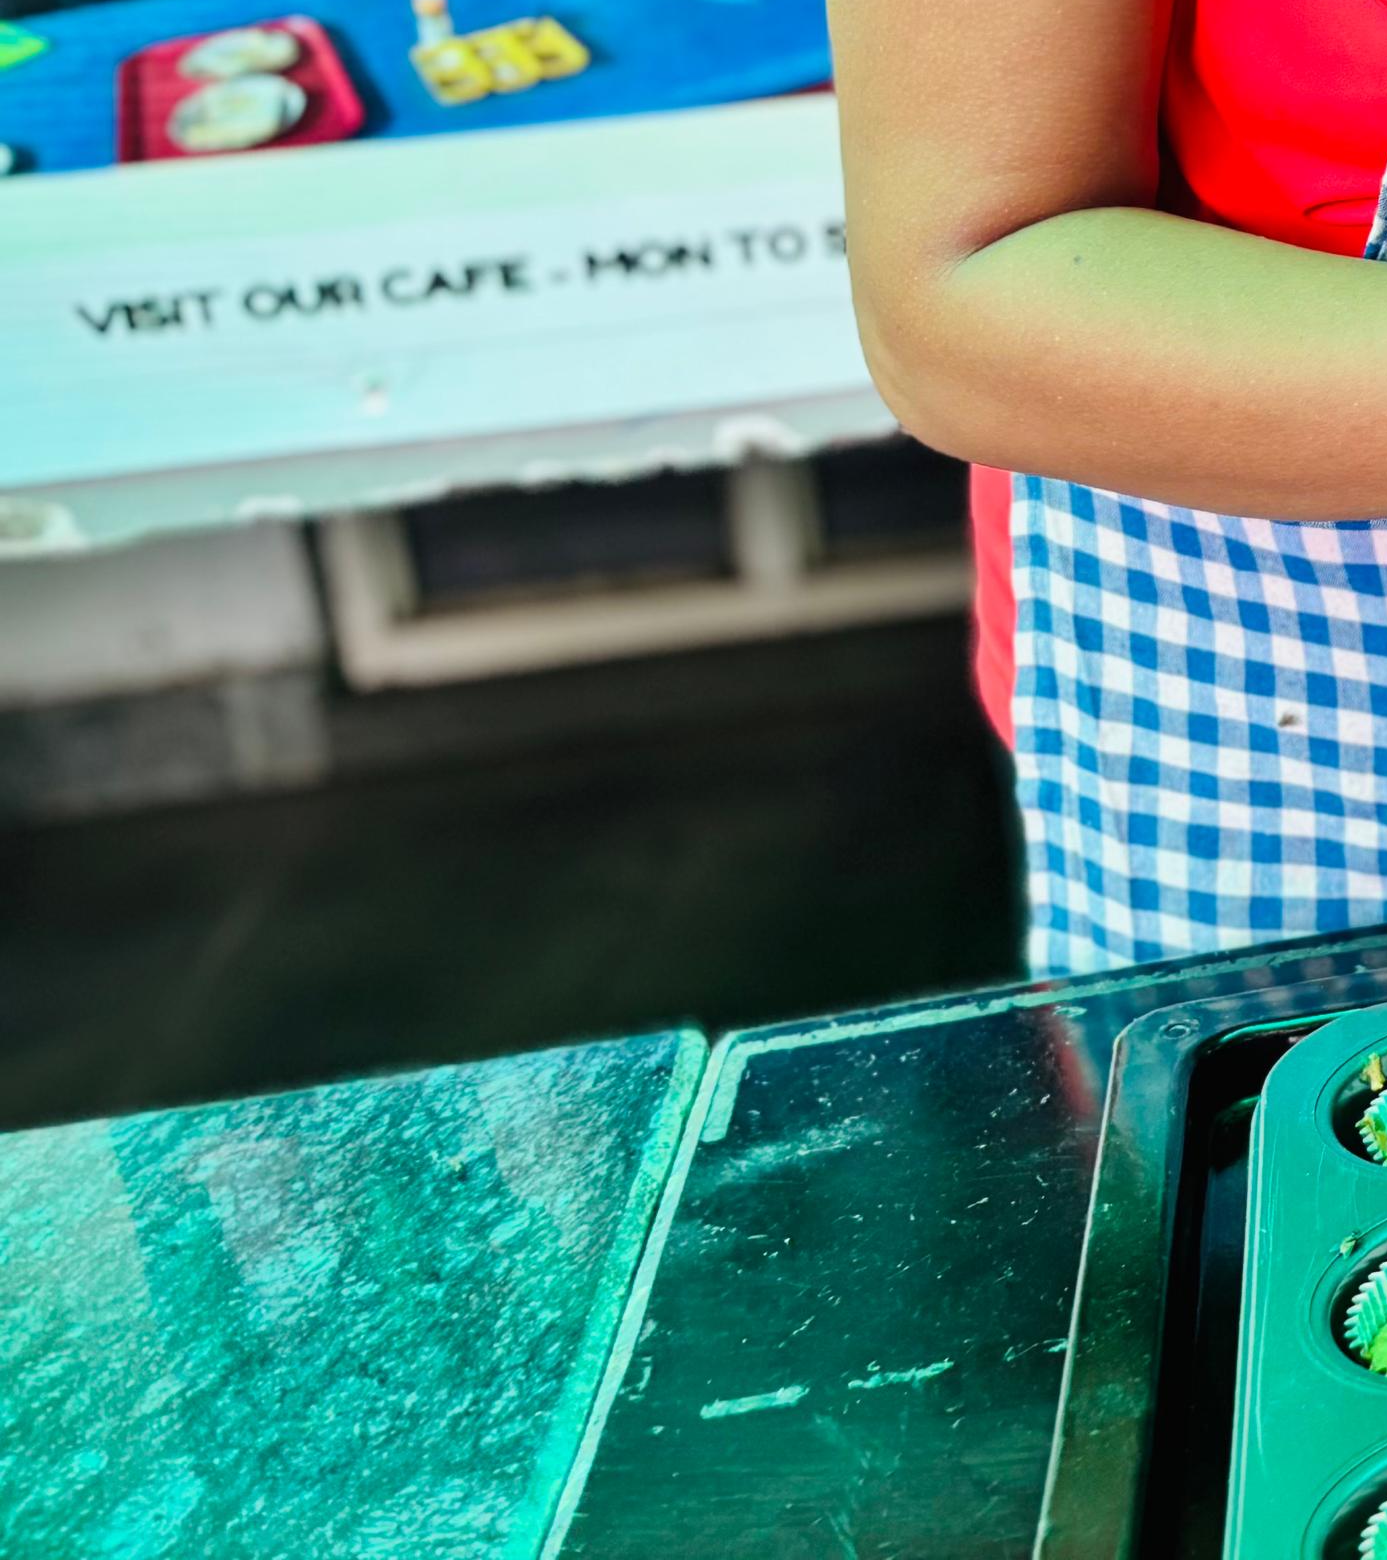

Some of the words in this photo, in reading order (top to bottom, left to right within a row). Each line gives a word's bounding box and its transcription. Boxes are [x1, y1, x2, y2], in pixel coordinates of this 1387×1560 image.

[77, 287, 222, 333] VISIT
[244, 276, 366, 321] OUR
[381, 255, 530, 304] CAFE
[730, 227, 808, 266] TO
